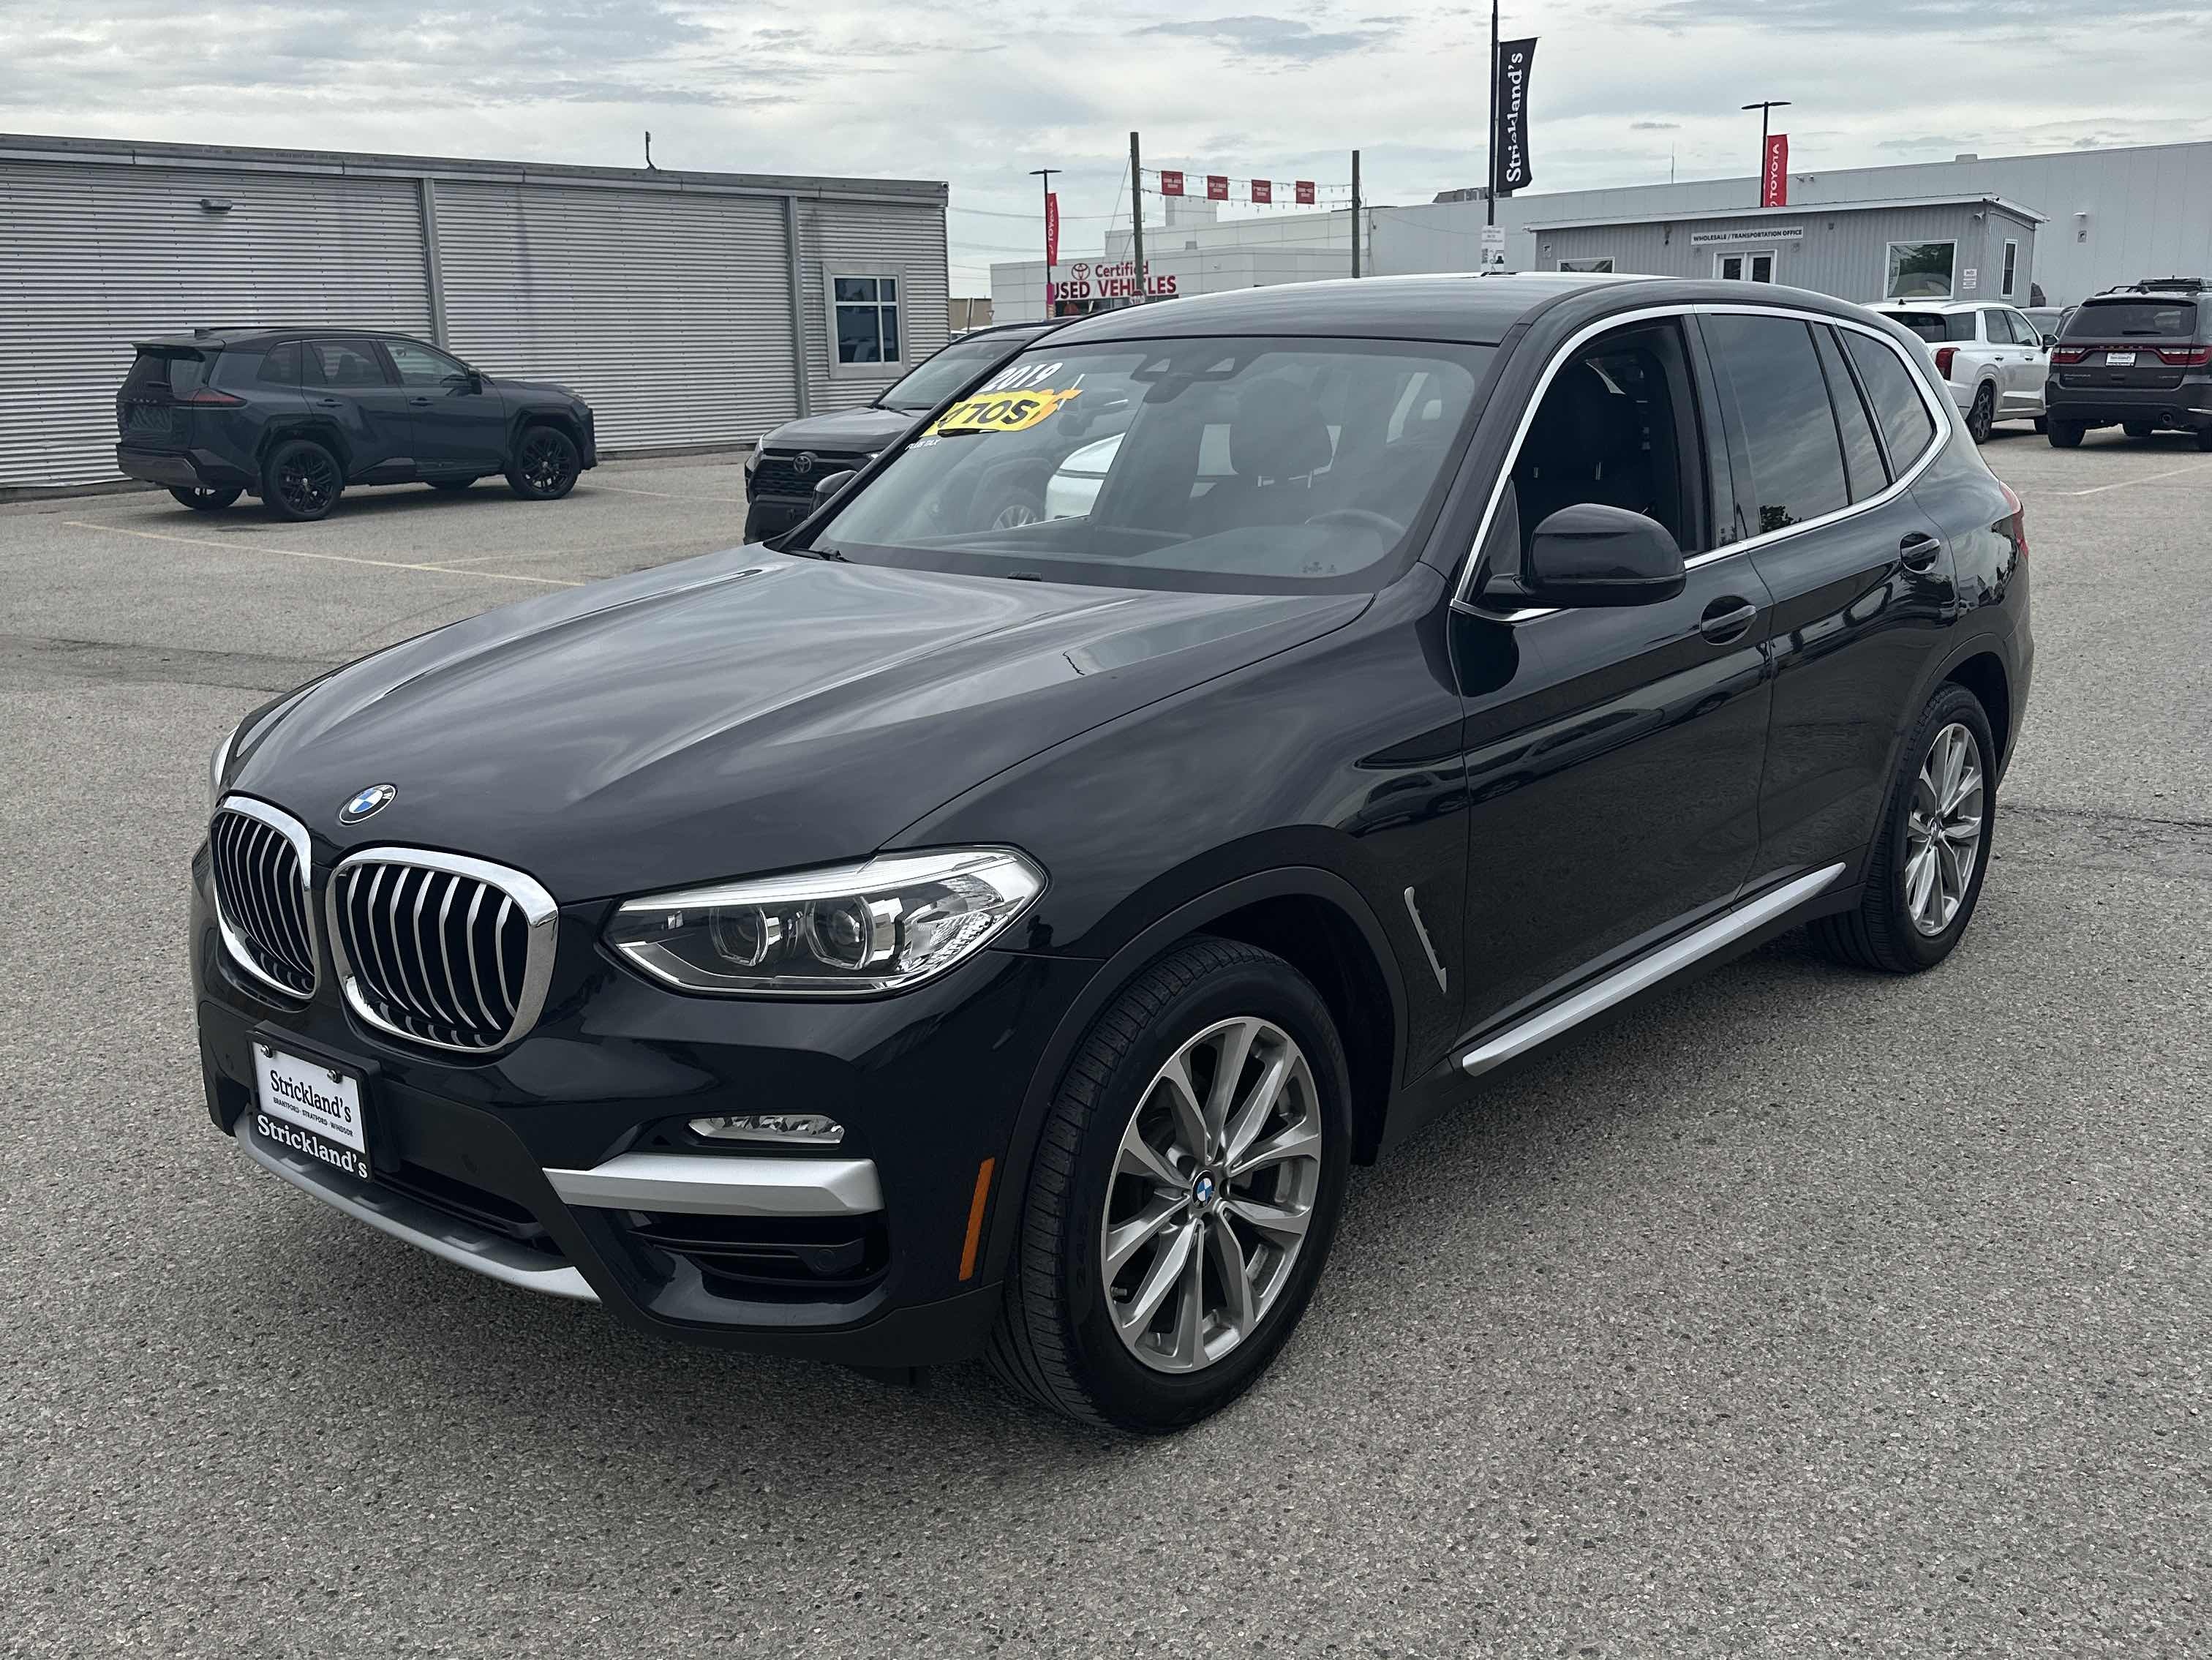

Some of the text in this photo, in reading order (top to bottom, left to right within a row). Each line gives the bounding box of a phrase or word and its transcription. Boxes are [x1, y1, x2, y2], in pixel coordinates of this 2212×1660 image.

[1506, 53, 1523, 182] Strickland's
[1770, 143, 1779, 198] TOYOTA
[1693, 233, 1726, 241] WHOLESALE
[1731, 230, 1782, 240] TRANSPORTATION
[1095, 260, 1148, 277] Certifid
[1098, 275, 1176, 297] VEHILES
[978, 362, 1063, 392] 2019
[270, 1070, 352, 1123] Strickland's
[257, 1114, 368, 1179] Strickland's
